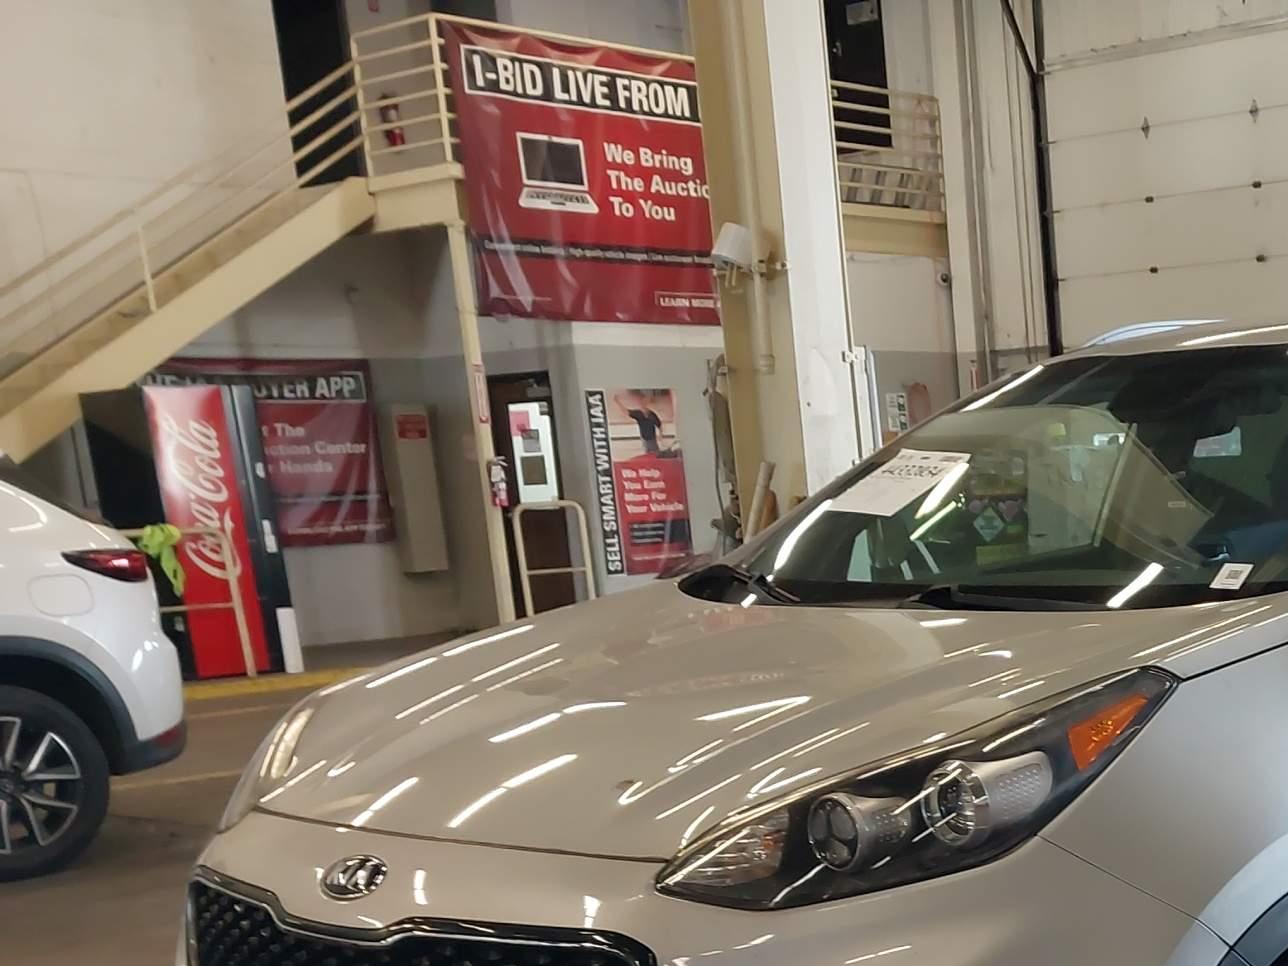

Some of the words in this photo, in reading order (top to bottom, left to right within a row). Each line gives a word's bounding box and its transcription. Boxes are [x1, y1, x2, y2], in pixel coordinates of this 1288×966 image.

[472, 53, 544, 97] I-BID
[551, 66, 611, 107] LIVE
[615, 78, 691, 118] FROM
[603, 142, 636, 165] We
[638, 146, 694, 176] Bring
[606, 169, 645, 192] The
[608, 196, 635, 218] To
[638, 198, 676, 221] You
[314, 376, 356, 398] APP
[589, 393, 606, 426] IAA
[593, 428, 611, 470] WITH
[598, 475, 618, 532] SMART
[605, 534, 623, 572] SELL
